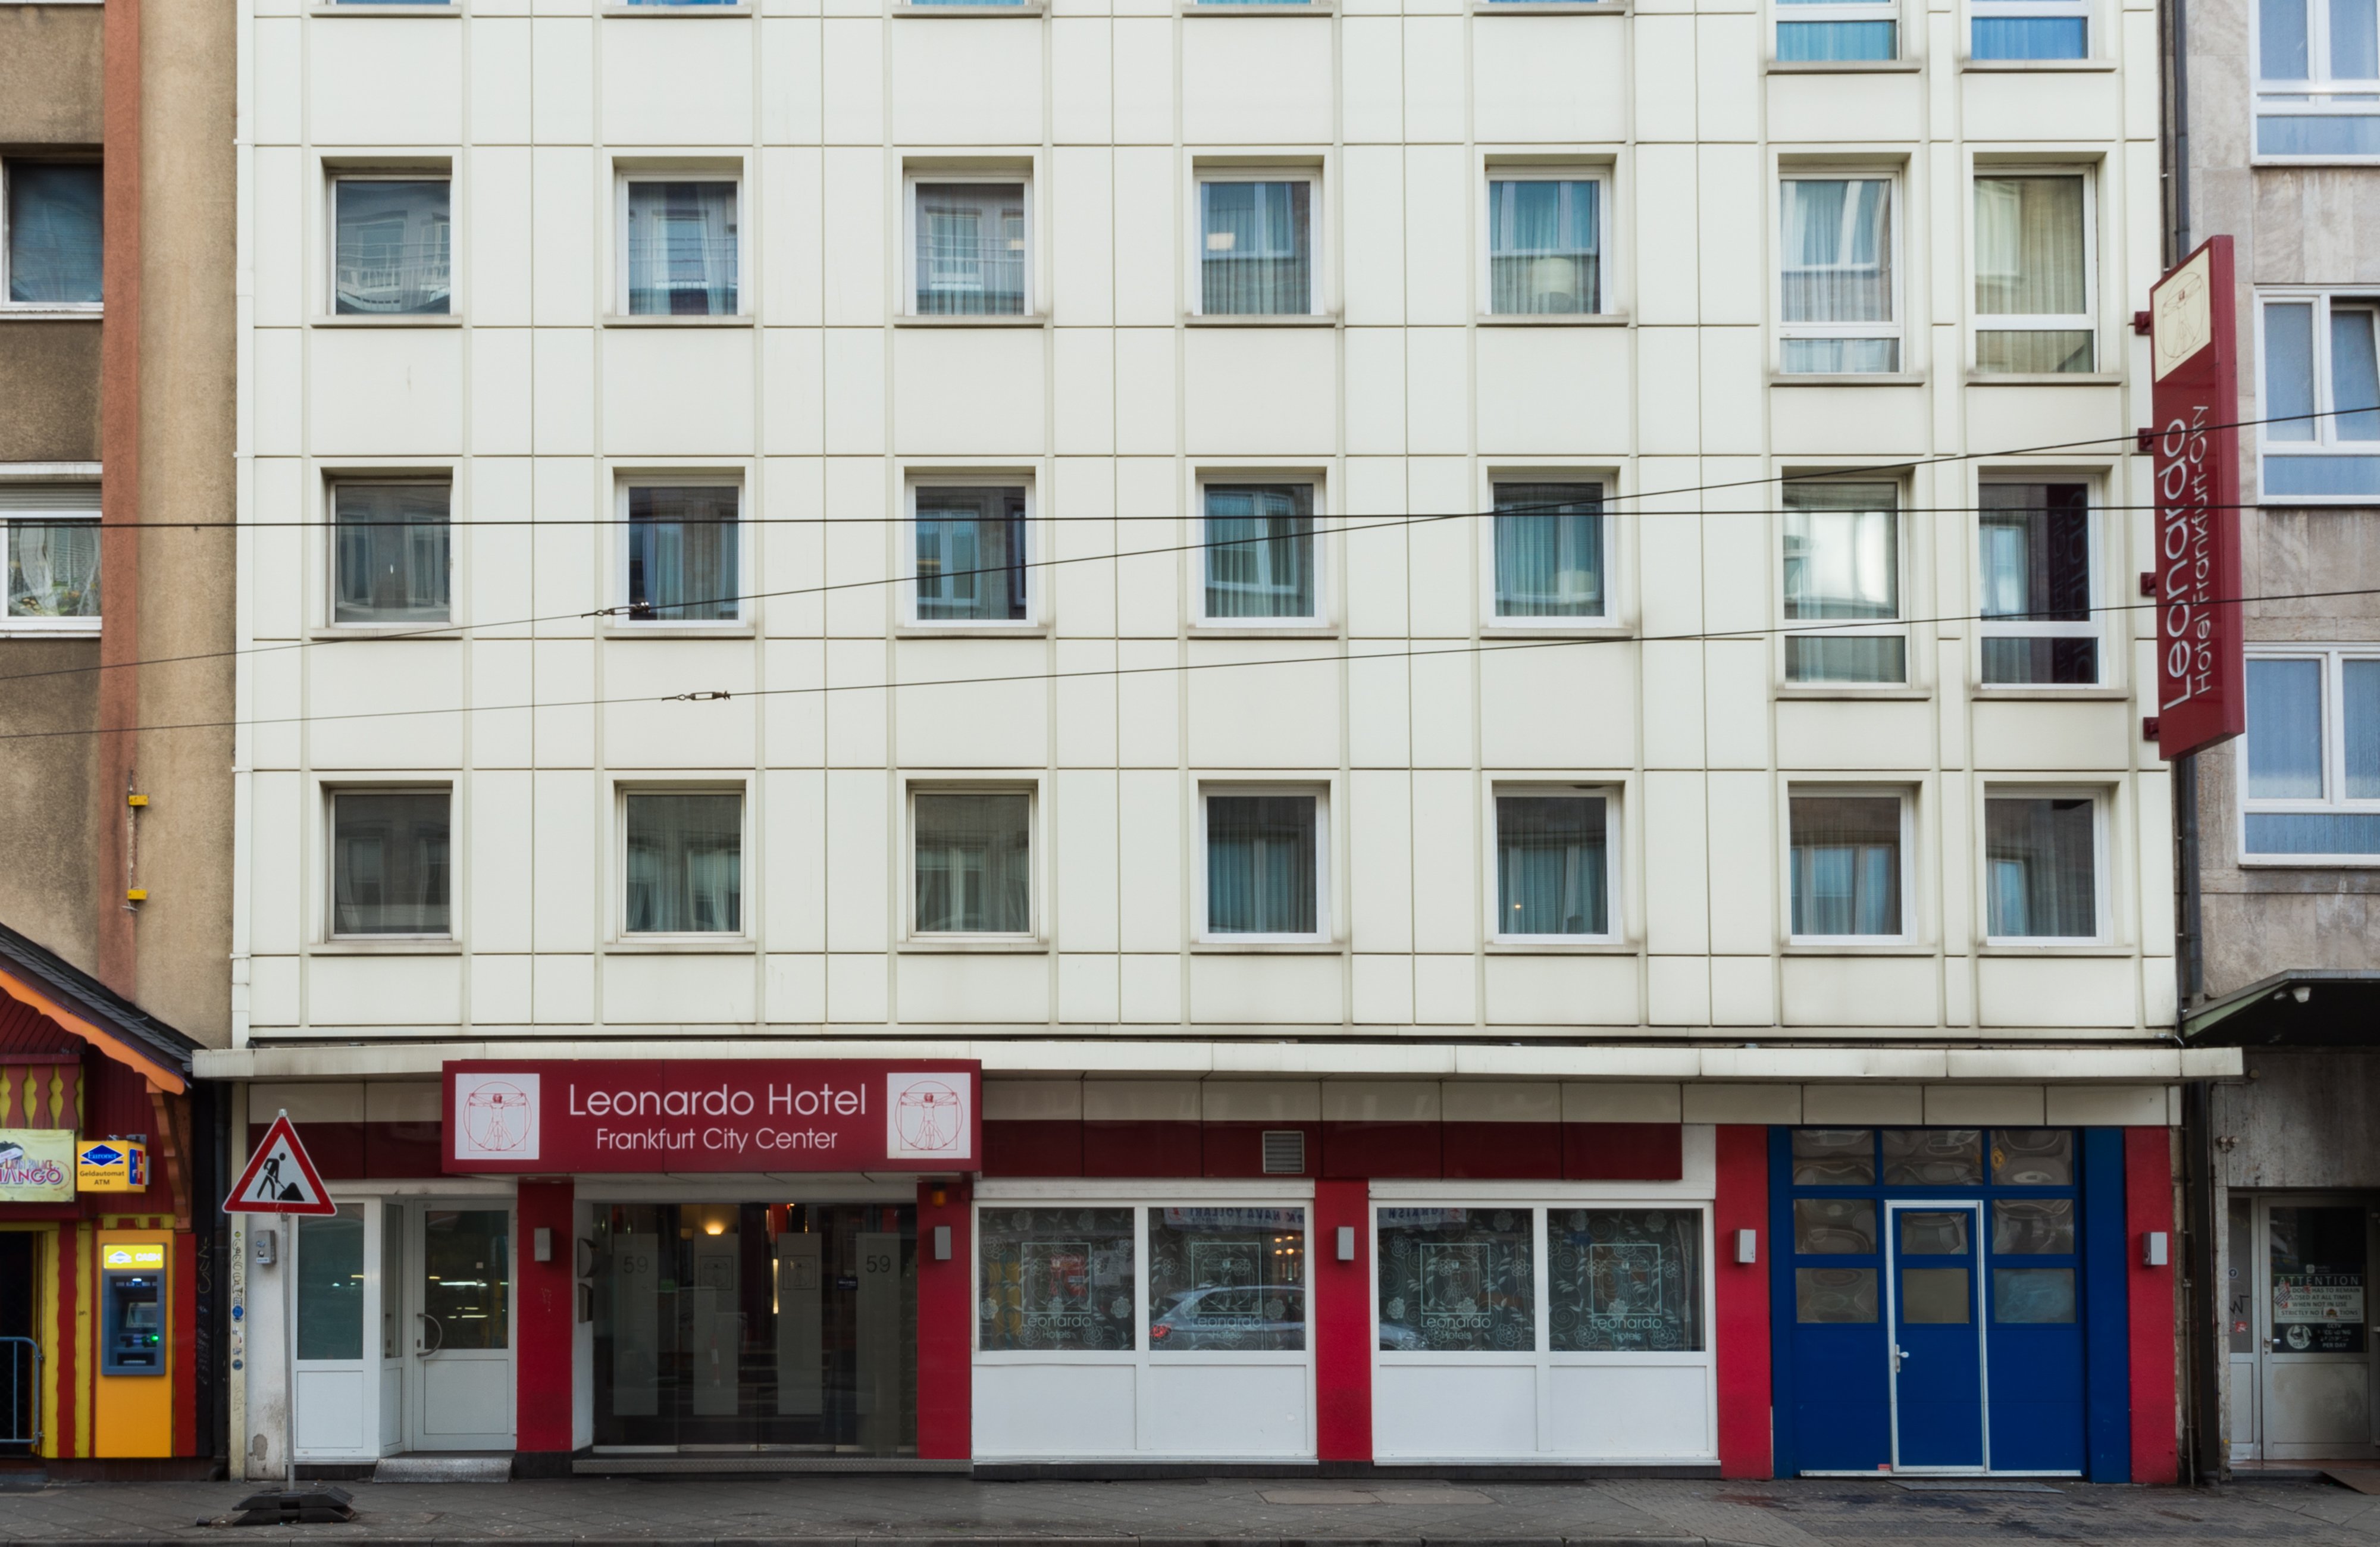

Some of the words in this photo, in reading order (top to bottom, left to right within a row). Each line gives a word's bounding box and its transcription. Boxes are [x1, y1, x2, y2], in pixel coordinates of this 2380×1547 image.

[2157, 418, 2191, 710] Leonardo
[2194, 612, 2212, 695] Hotel
[570, 1084, 754, 1116] Leonardo
[769, 1083, 865, 1115] Hotel
[597, 1128, 695, 1150] Frankfurt
[703, 1128, 749, 1153] City
[756, 1128, 837, 1149] Center
[88, 1151, 117, 1160] Euronet
[136, 1253, 161, 1261] CASH
[624, 1256, 649, 1273] 59
[866, 1255, 891, 1273] 59
[2279, 1276, 2358, 1285] ATTENTION
[1022, 1314, 1091, 1327] Leonardo
[1192, 1315, 1261, 1327] Leonardo
[1421, 1316, 1491, 1328] Leonardo
[1592, 1316, 1662, 1329] Leonardo
[1042, 1329, 1071, 1339] Hotels
[1441, 1330, 1471, 1339] Hotels
[1612, 1331, 1642, 1341] Hotels
